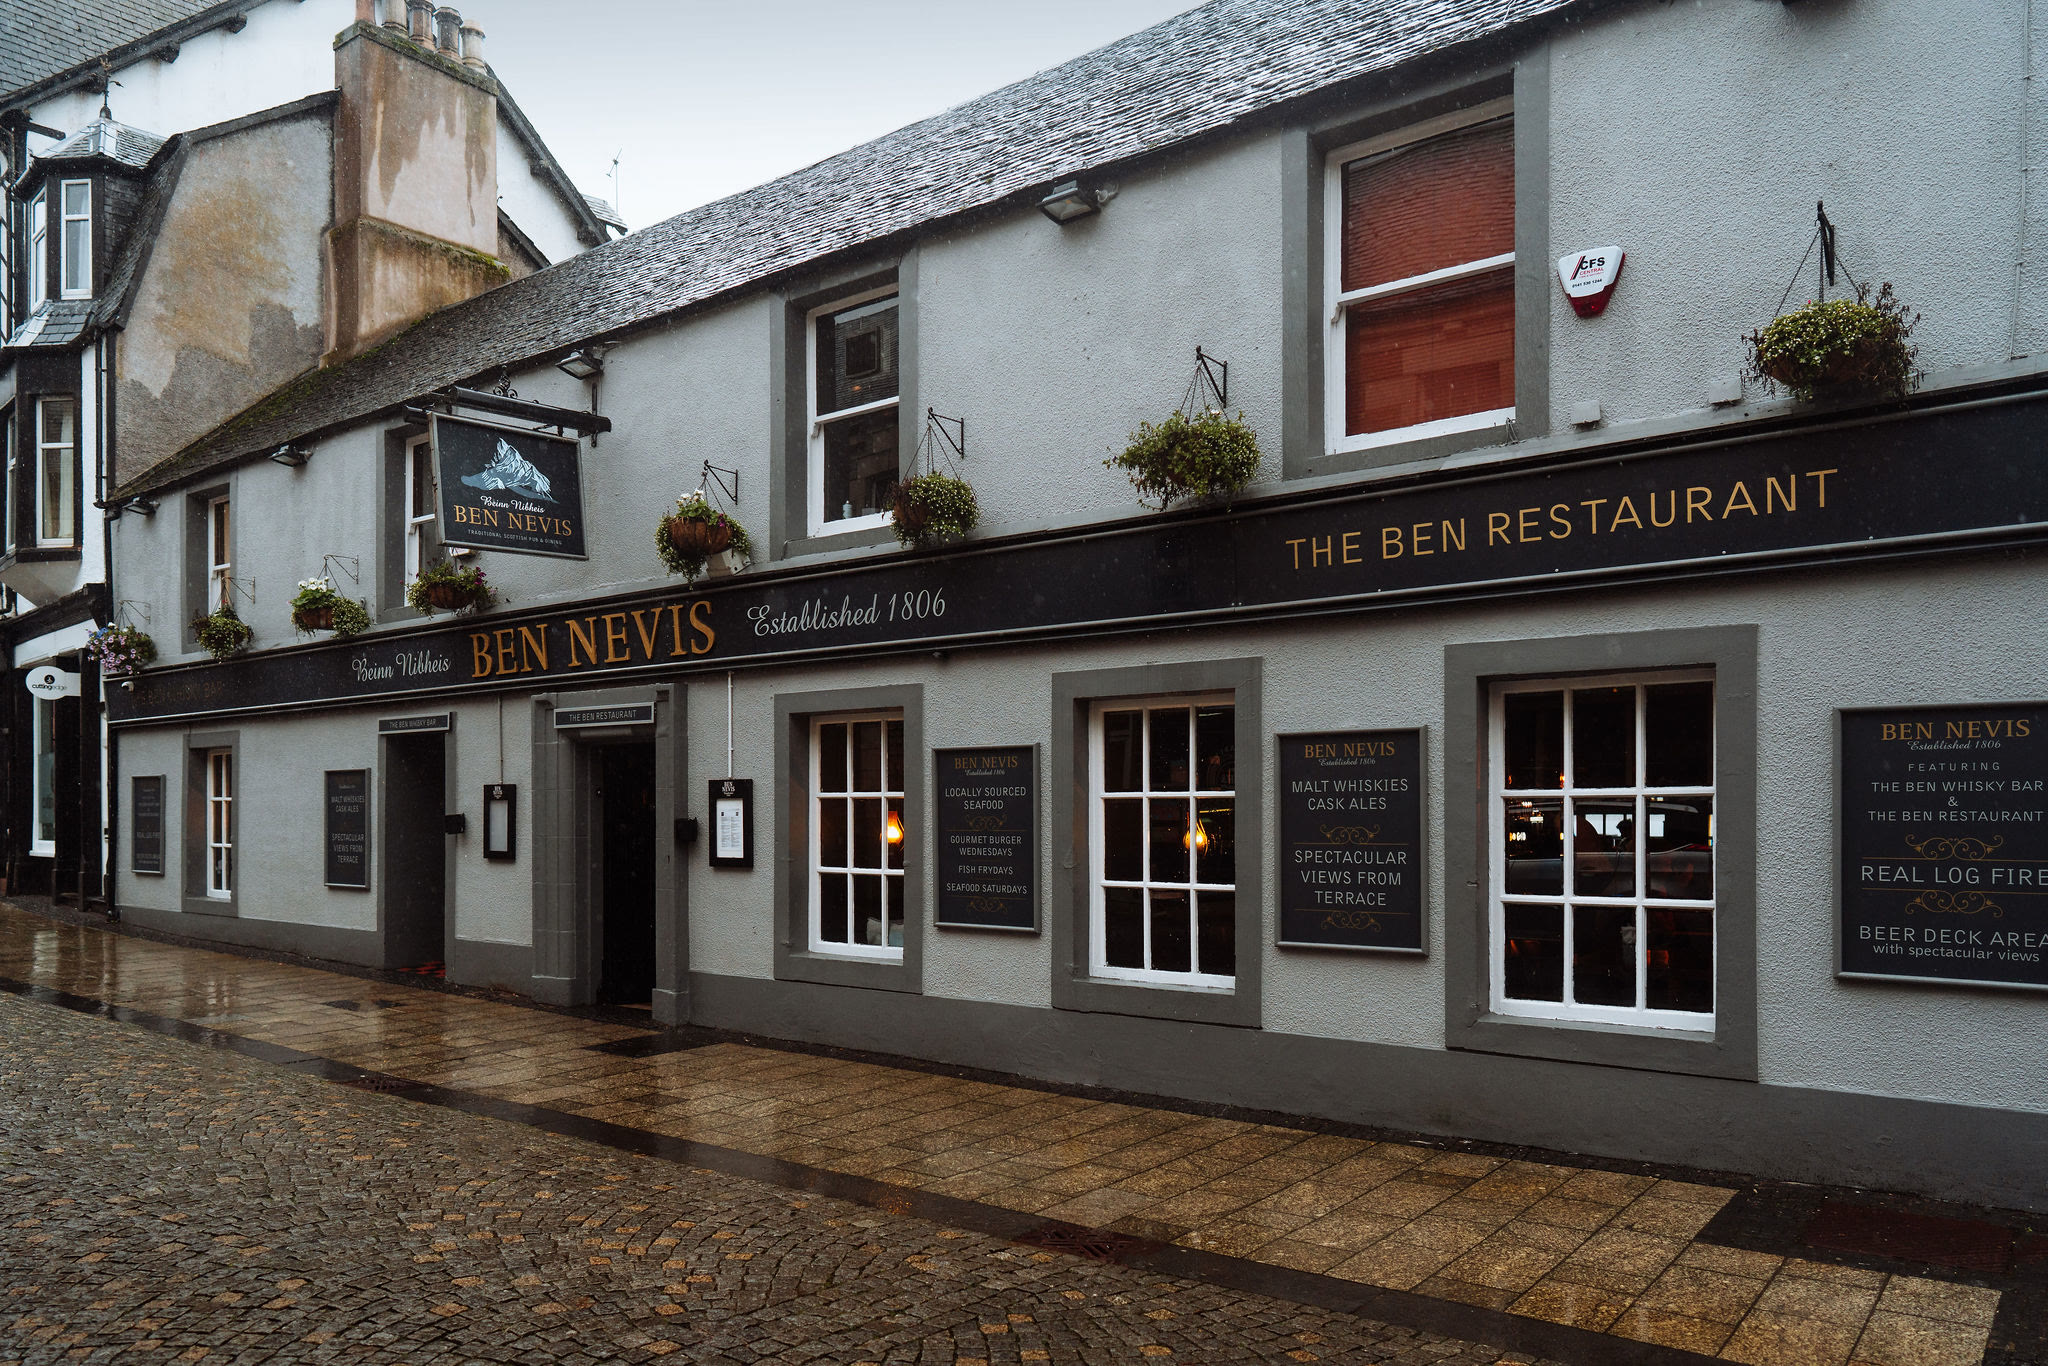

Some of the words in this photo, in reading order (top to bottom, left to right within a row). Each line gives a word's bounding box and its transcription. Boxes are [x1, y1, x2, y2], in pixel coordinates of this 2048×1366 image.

[1580, 256, 1605, 270] CFS
[480, 496, 509, 508] Beinn
[511, 500, 545, 513] Nibheis
[454, 504, 498, 527] BEN
[507, 512, 572, 536] NEVIS
[1286, 531, 1362, 570] THE
[1382, 518, 1466, 560] BEN
[1488, 469, 1838, 546] RESTAURANT
[468, 529, 502, 538] TRADITIONAL
[747, 594, 880, 636] Established
[889, 587, 946, 622] 1806
[470, 624, 548, 678] BEN
[566, 601, 716, 668] NEVIS
[352, 659, 394, 682] Beinn
[396, 651, 450, 676] Nibheis
[582, 713, 594, 721] BEN
[597, 710, 636, 720] RESTAURANT
[1881, 722, 1934, 740] BEN
[1945, 719, 2030, 739] NEVIS
[1304, 744, 1337, 758] BEN
[1344, 741, 1395, 756] NEVIS
[1907, 740, 1971, 750] Established
[1975, 740, 2001, 749] 1806
[954, 757, 977, 769] BEN
[982, 756, 1018, 768] NEVIS
[1318, 758, 1358, 767] Established
[1909, 762, 2000, 772] FEATURING
[945, 788, 982, 797] LOCALLY
[984, 786, 1027, 796] SOURCED
[1292, 780, 1329, 793] MALT
[1334, 778, 1408, 792] WHISKIES
[1872, 782, 1900, 792] THE
[1906, 782, 1936, 792] BEN
[1942, 781, 2005, 792] WHISKY
[2012, 780, 2044, 791] BAR
[964, 800, 1004, 810] SEAFOOD
[1308, 798, 1345, 811] CASK
[1349, 797, 1387, 810] ALES
[1948, 796, 1958, 807] &
[1868, 811, 1896, 821] THE
[1902, 811, 1932, 821] BEN
[1939, 811, 2044, 822] RESTAURANT
[951, 835, 987, 844] GOURMET
[990, 836, 1022, 844] BURGER
[960, 847, 1013, 856] WEDNESDAYS
[1294, 850, 1407, 865] SPECTACULAR
[958, 865, 976, 874] FISH
[978, 866, 1013, 875] FRYDAYS
[1861, 866, 1925, 882] REAL
[1935, 867, 1980, 884] LOG
[1992, 868, 2048, 886] FIRE
[1301, 870, 1351, 884] VIEWS
[1358, 872, 1401, 885] FROM
[946, 882, 980, 892] SEAFOOD
[982, 884, 1028, 894] SATURDAYS
[1314, 890, 1386, 906] TERRACE
[1859, 925, 1915, 942] BEER
[1924, 928, 1982, 945] DECK
[1873, 943, 1903, 954] with
[1908, 946, 1993, 960] spectacular
[1998, 950, 2040, 962] views
